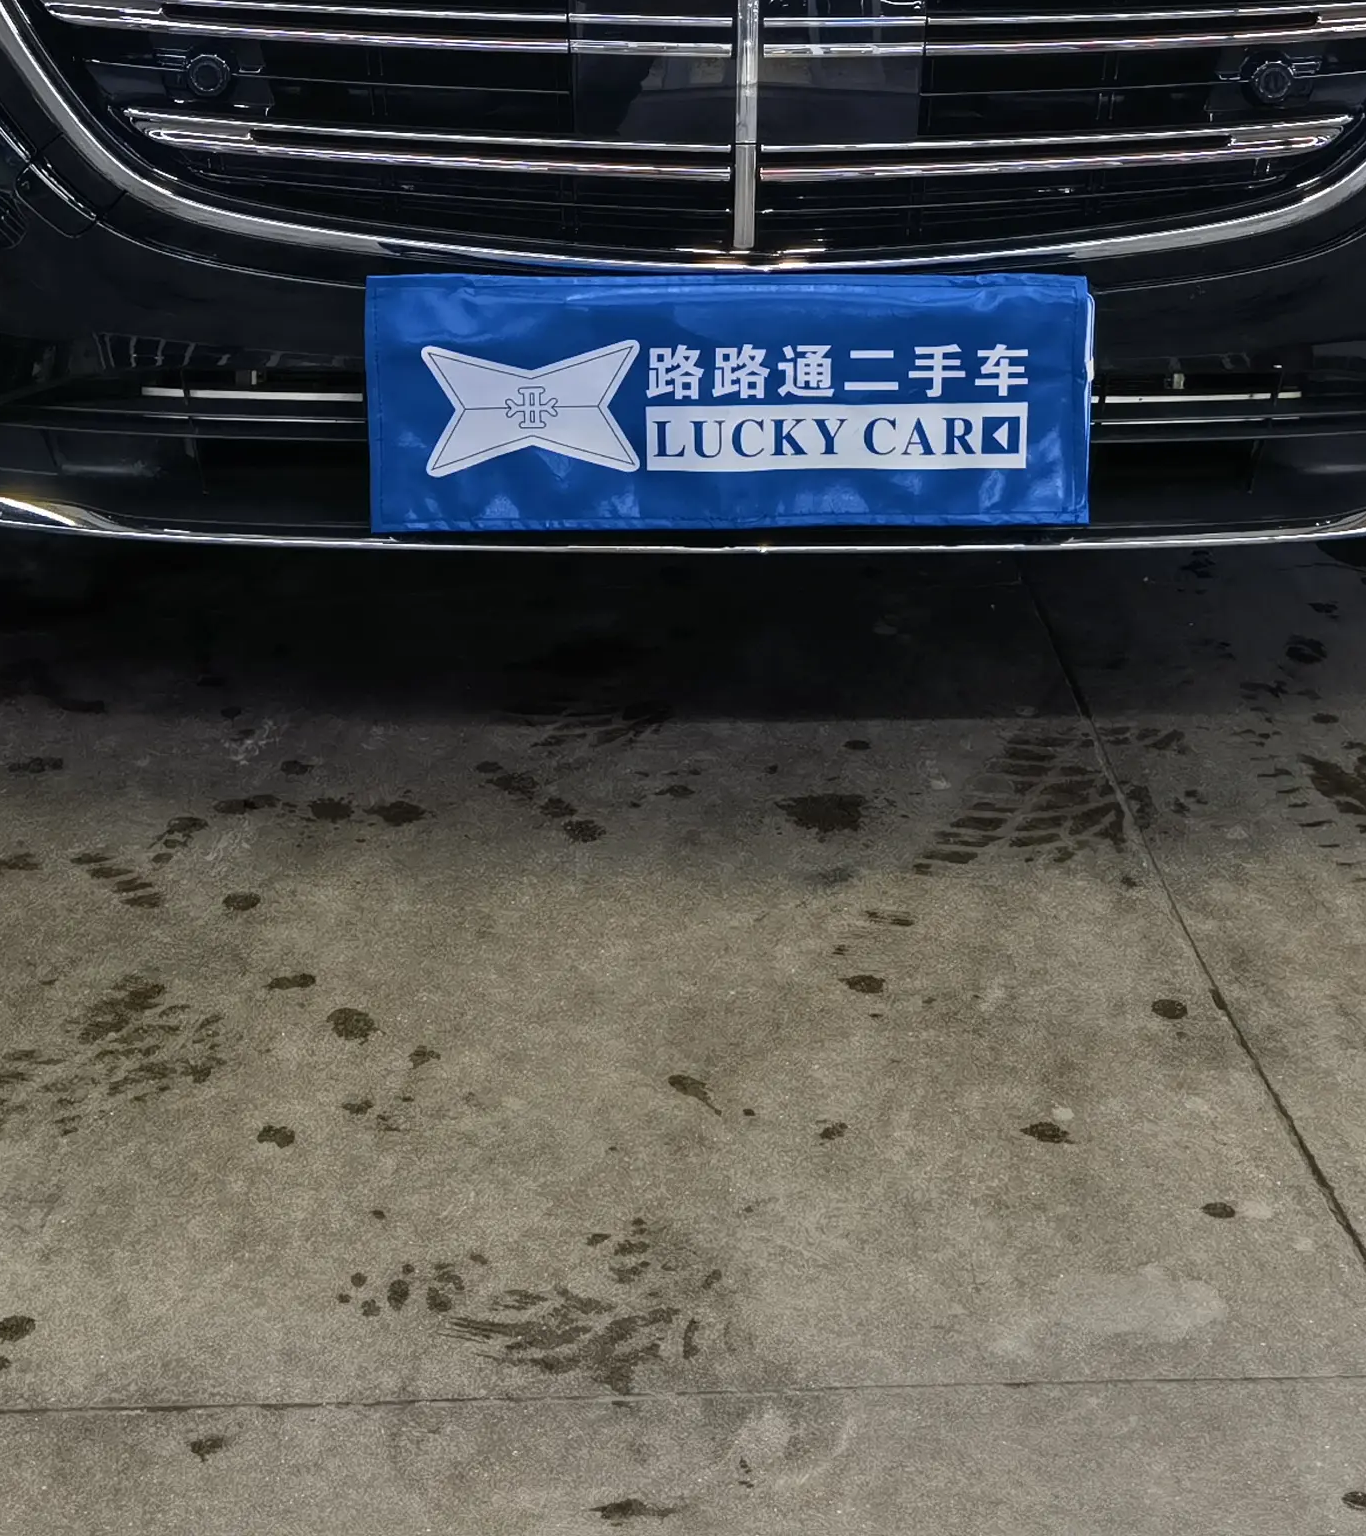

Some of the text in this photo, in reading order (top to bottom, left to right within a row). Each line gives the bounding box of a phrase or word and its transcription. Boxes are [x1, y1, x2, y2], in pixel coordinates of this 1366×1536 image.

[646, 344, 1029, 400] 路路通二手车
[652, 417, 976, 459] LUCKY CAR
